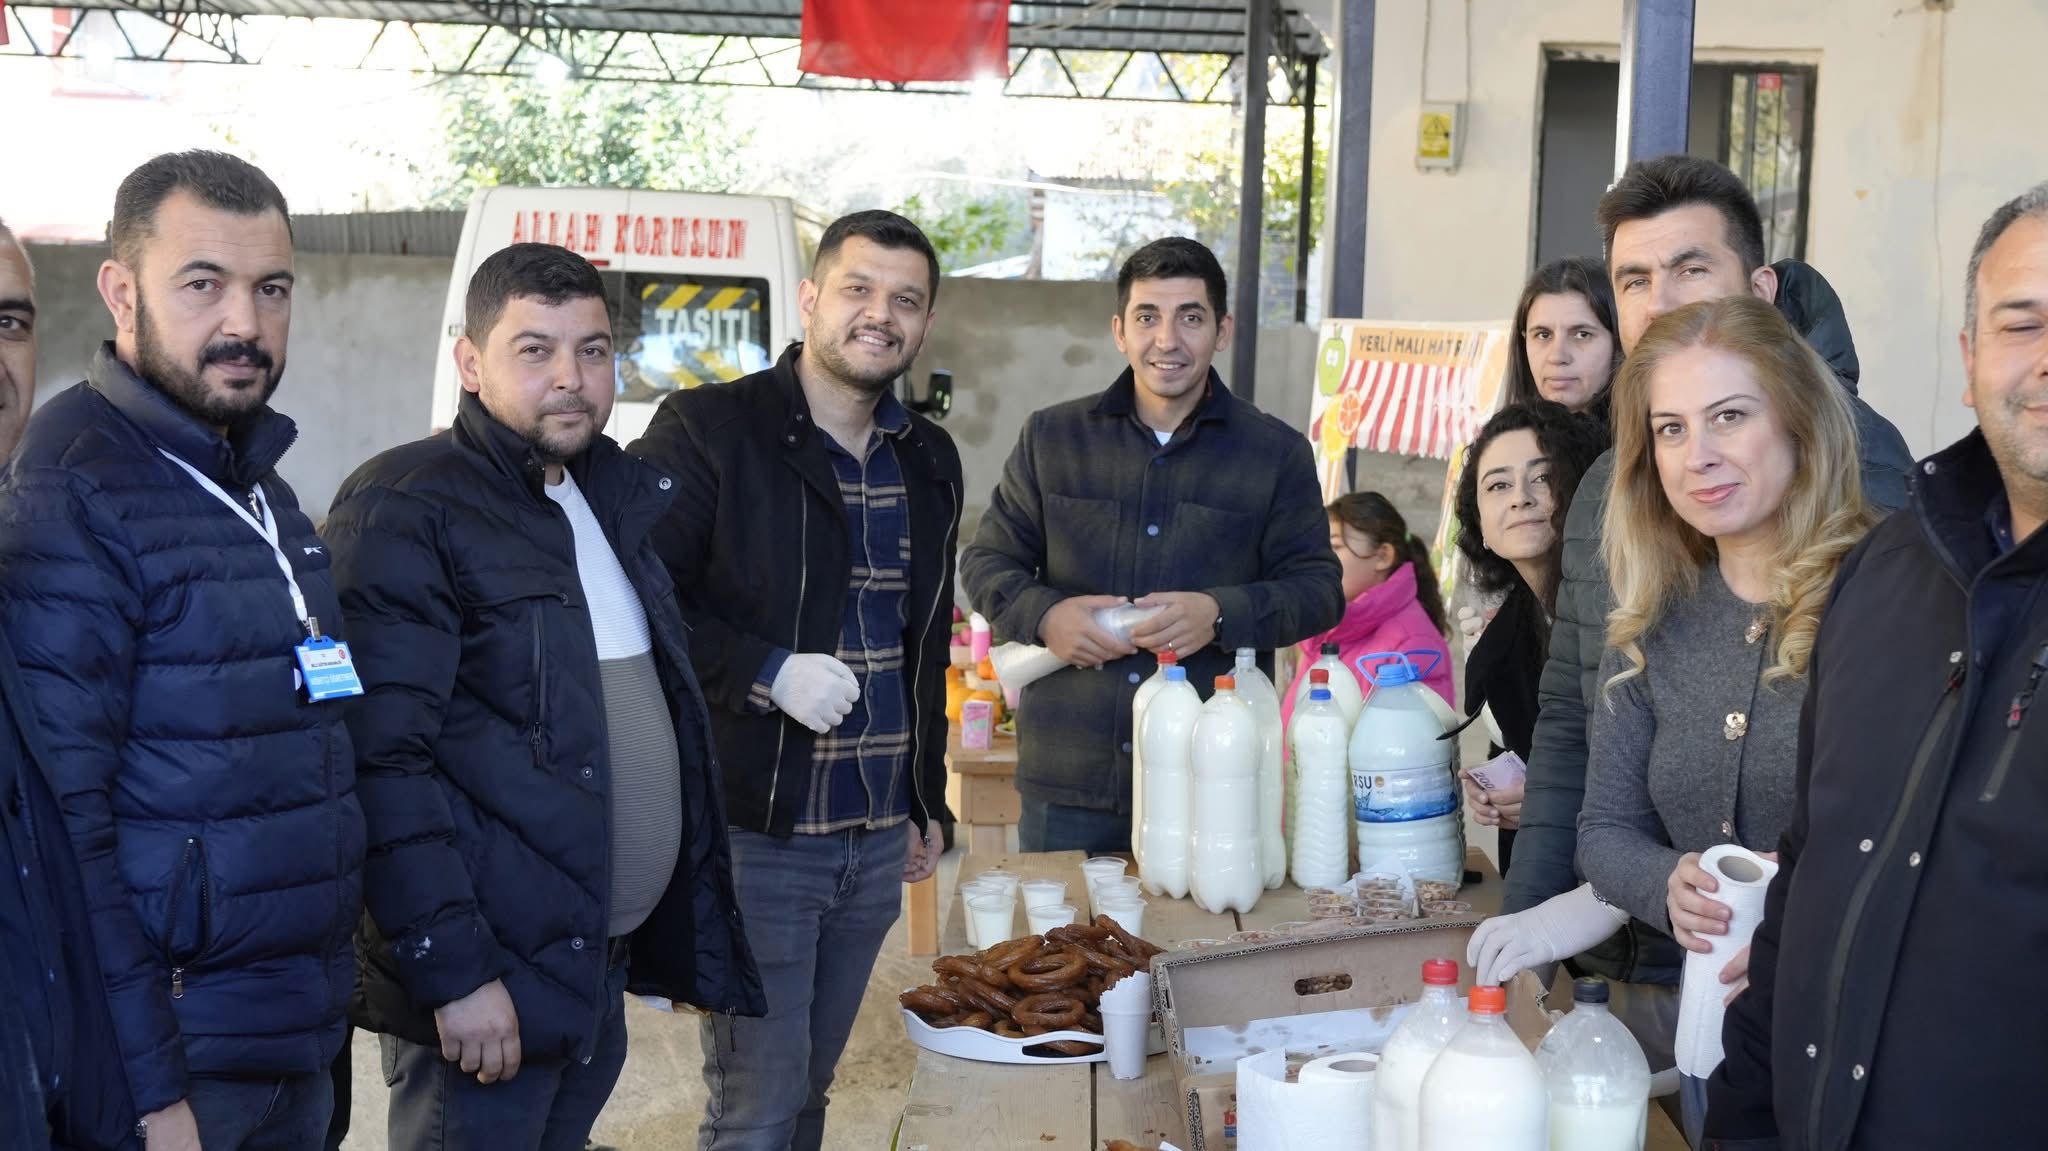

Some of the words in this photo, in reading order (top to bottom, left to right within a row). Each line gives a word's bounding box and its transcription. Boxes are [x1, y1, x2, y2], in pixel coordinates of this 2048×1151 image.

[511, 211, 602, 252] ALLAH
[614, 213, 748, 260] KORUSUN
[1359, 330, 1393, 353] YERLİ
[1394, 335, 1425, 355] MALI
[1472, 771, 1496, 789] 200
